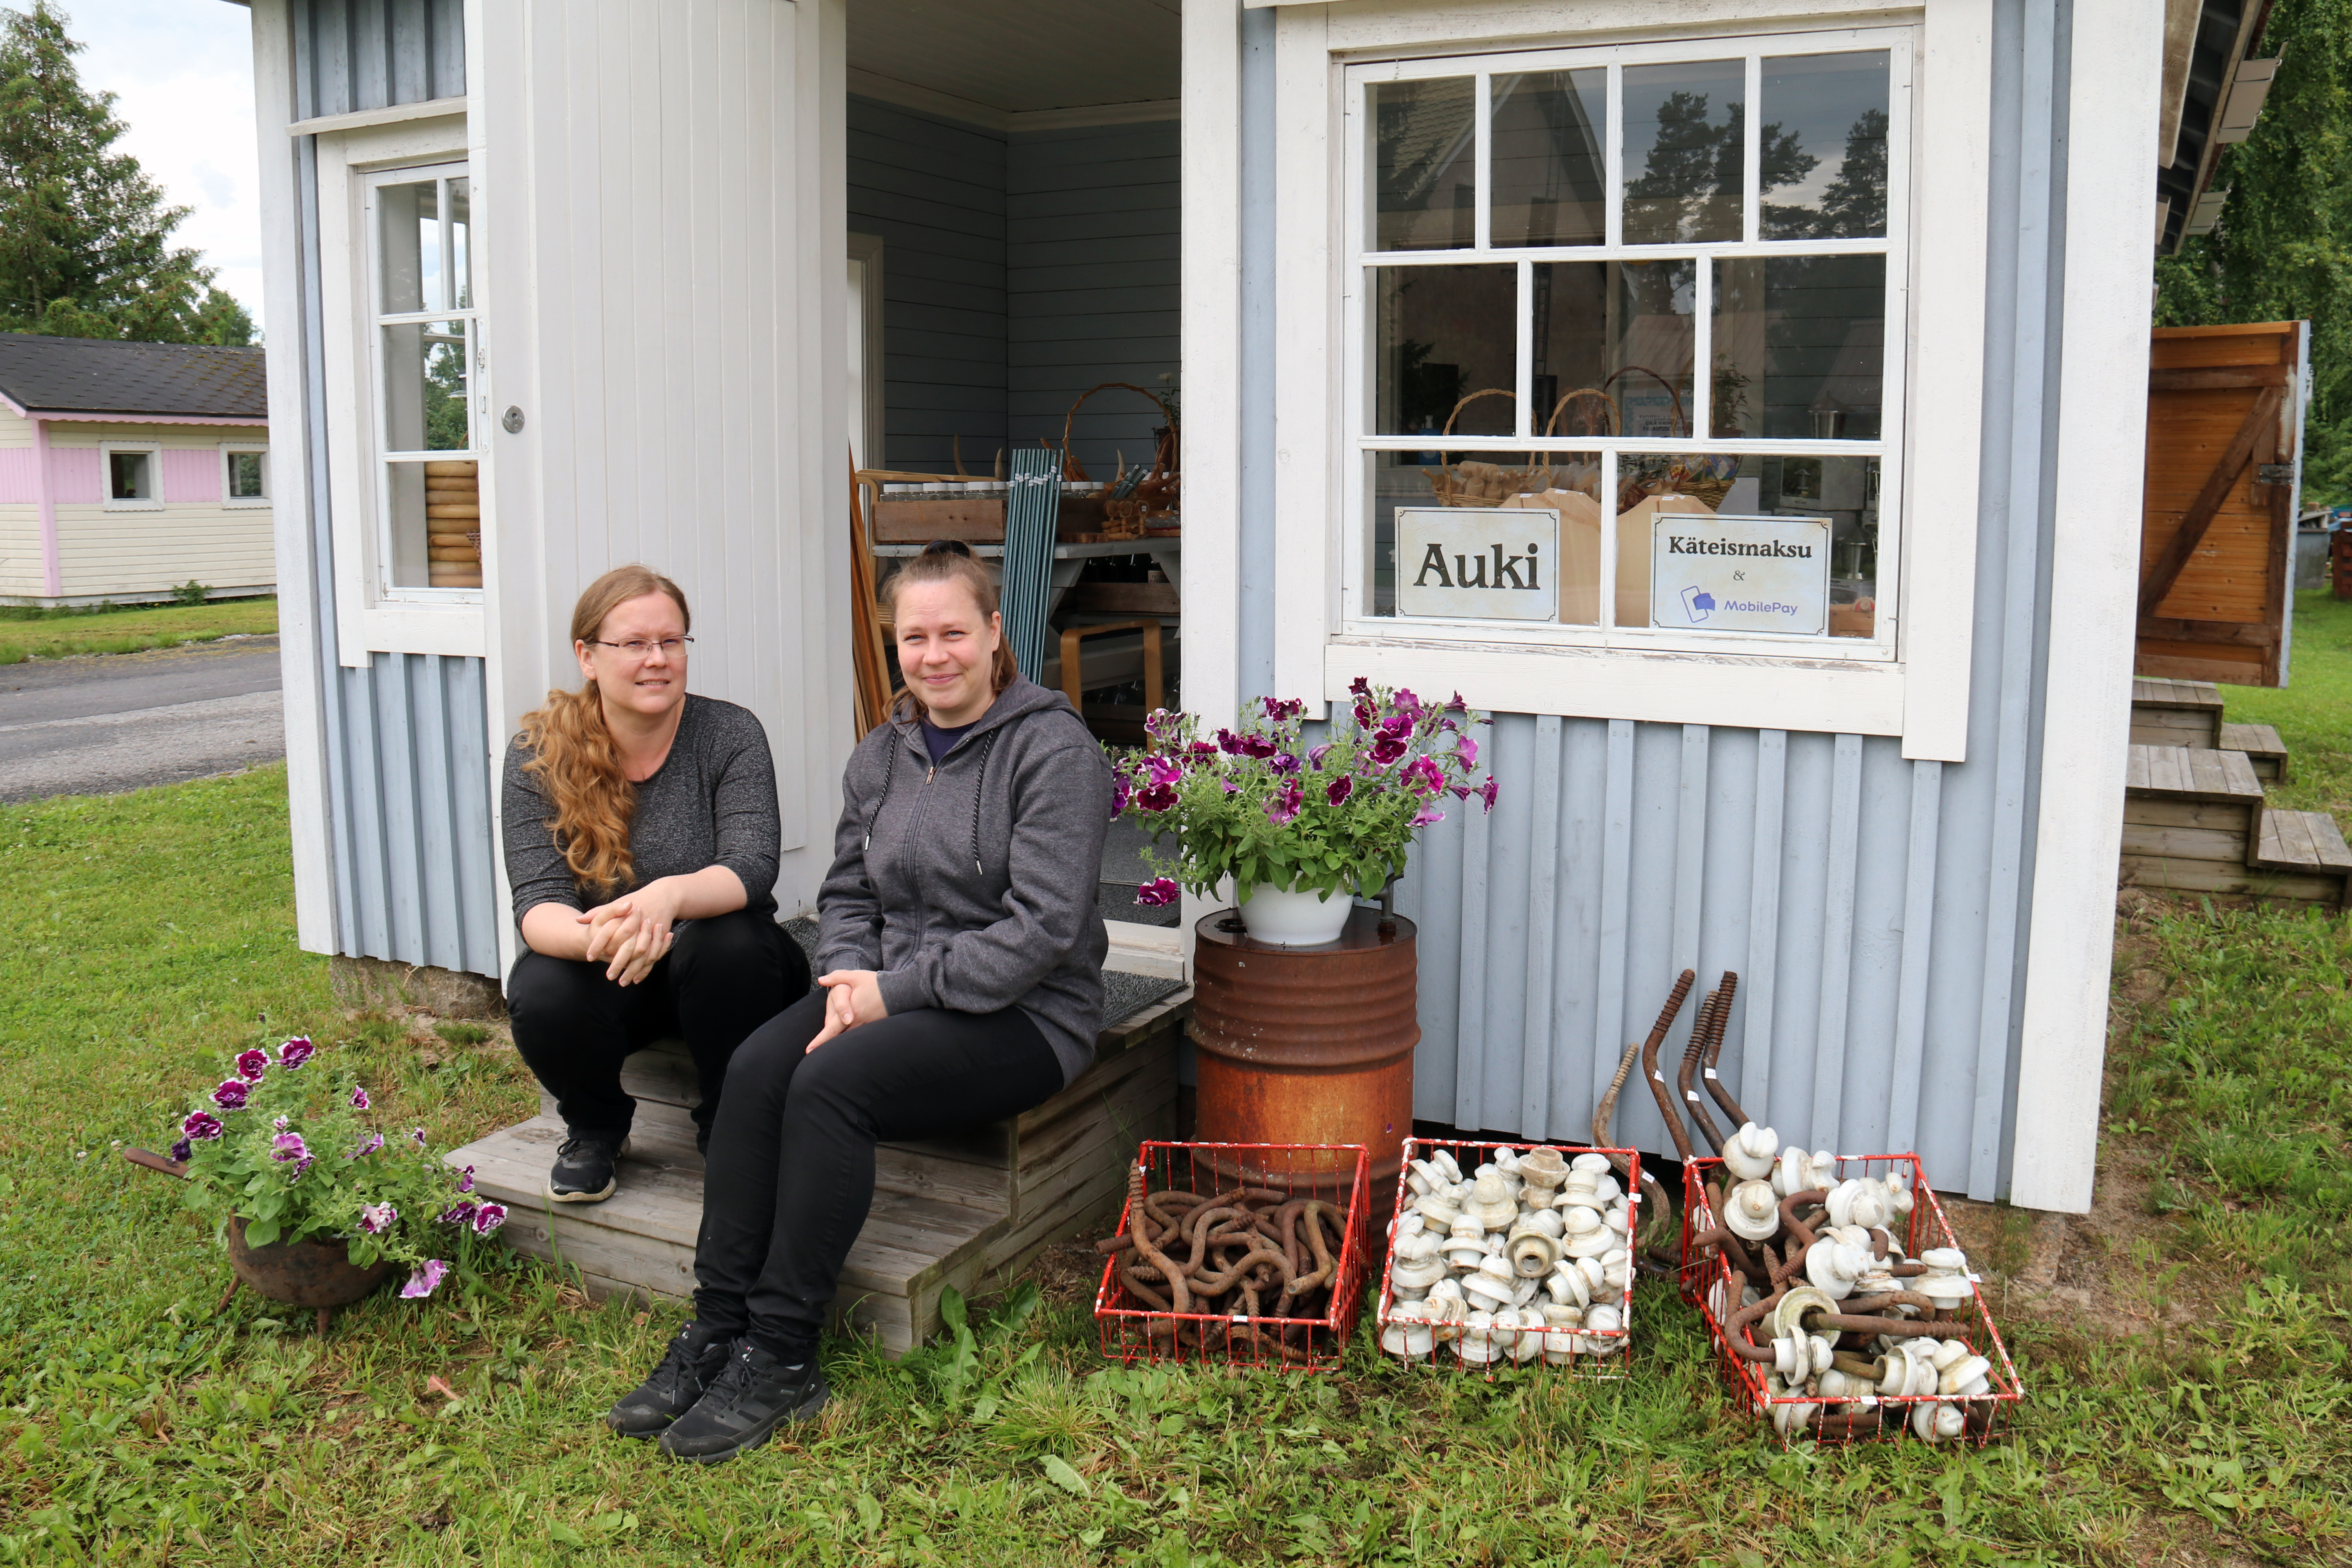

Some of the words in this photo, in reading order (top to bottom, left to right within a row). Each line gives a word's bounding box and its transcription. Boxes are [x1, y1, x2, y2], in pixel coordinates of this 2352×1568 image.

[1669, 536, 1812, 559] Käteismaksu
[1413, 543, 1541, 590] Auki
[1733, 570, 1745, 581] &
[1724, 600, 1798, 616] MobilePay
